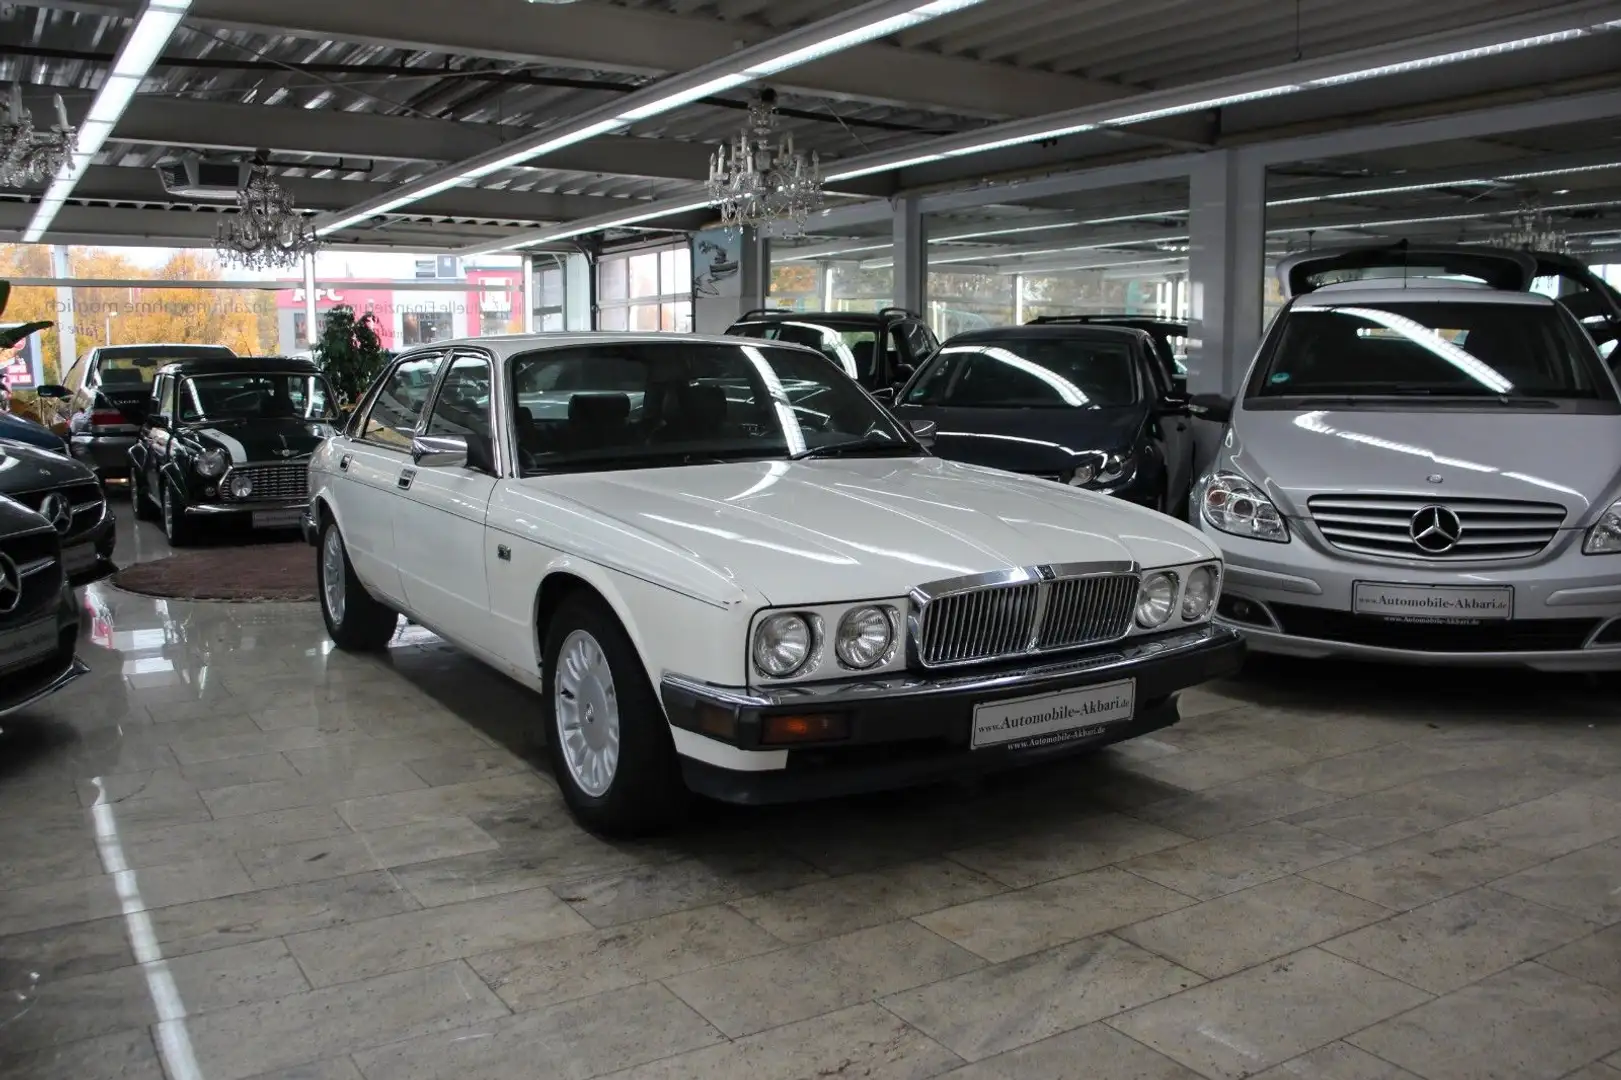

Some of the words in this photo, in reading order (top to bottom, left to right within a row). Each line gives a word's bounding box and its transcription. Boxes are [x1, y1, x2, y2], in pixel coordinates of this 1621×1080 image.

[1358, 595, 1507, 610] www.Automobile-Akbari.de
[978, 696, 1130, 733] www.Automobile-Akbari.de
[1007, 727, 1105, 750] www.Automobile-Akbari.de
